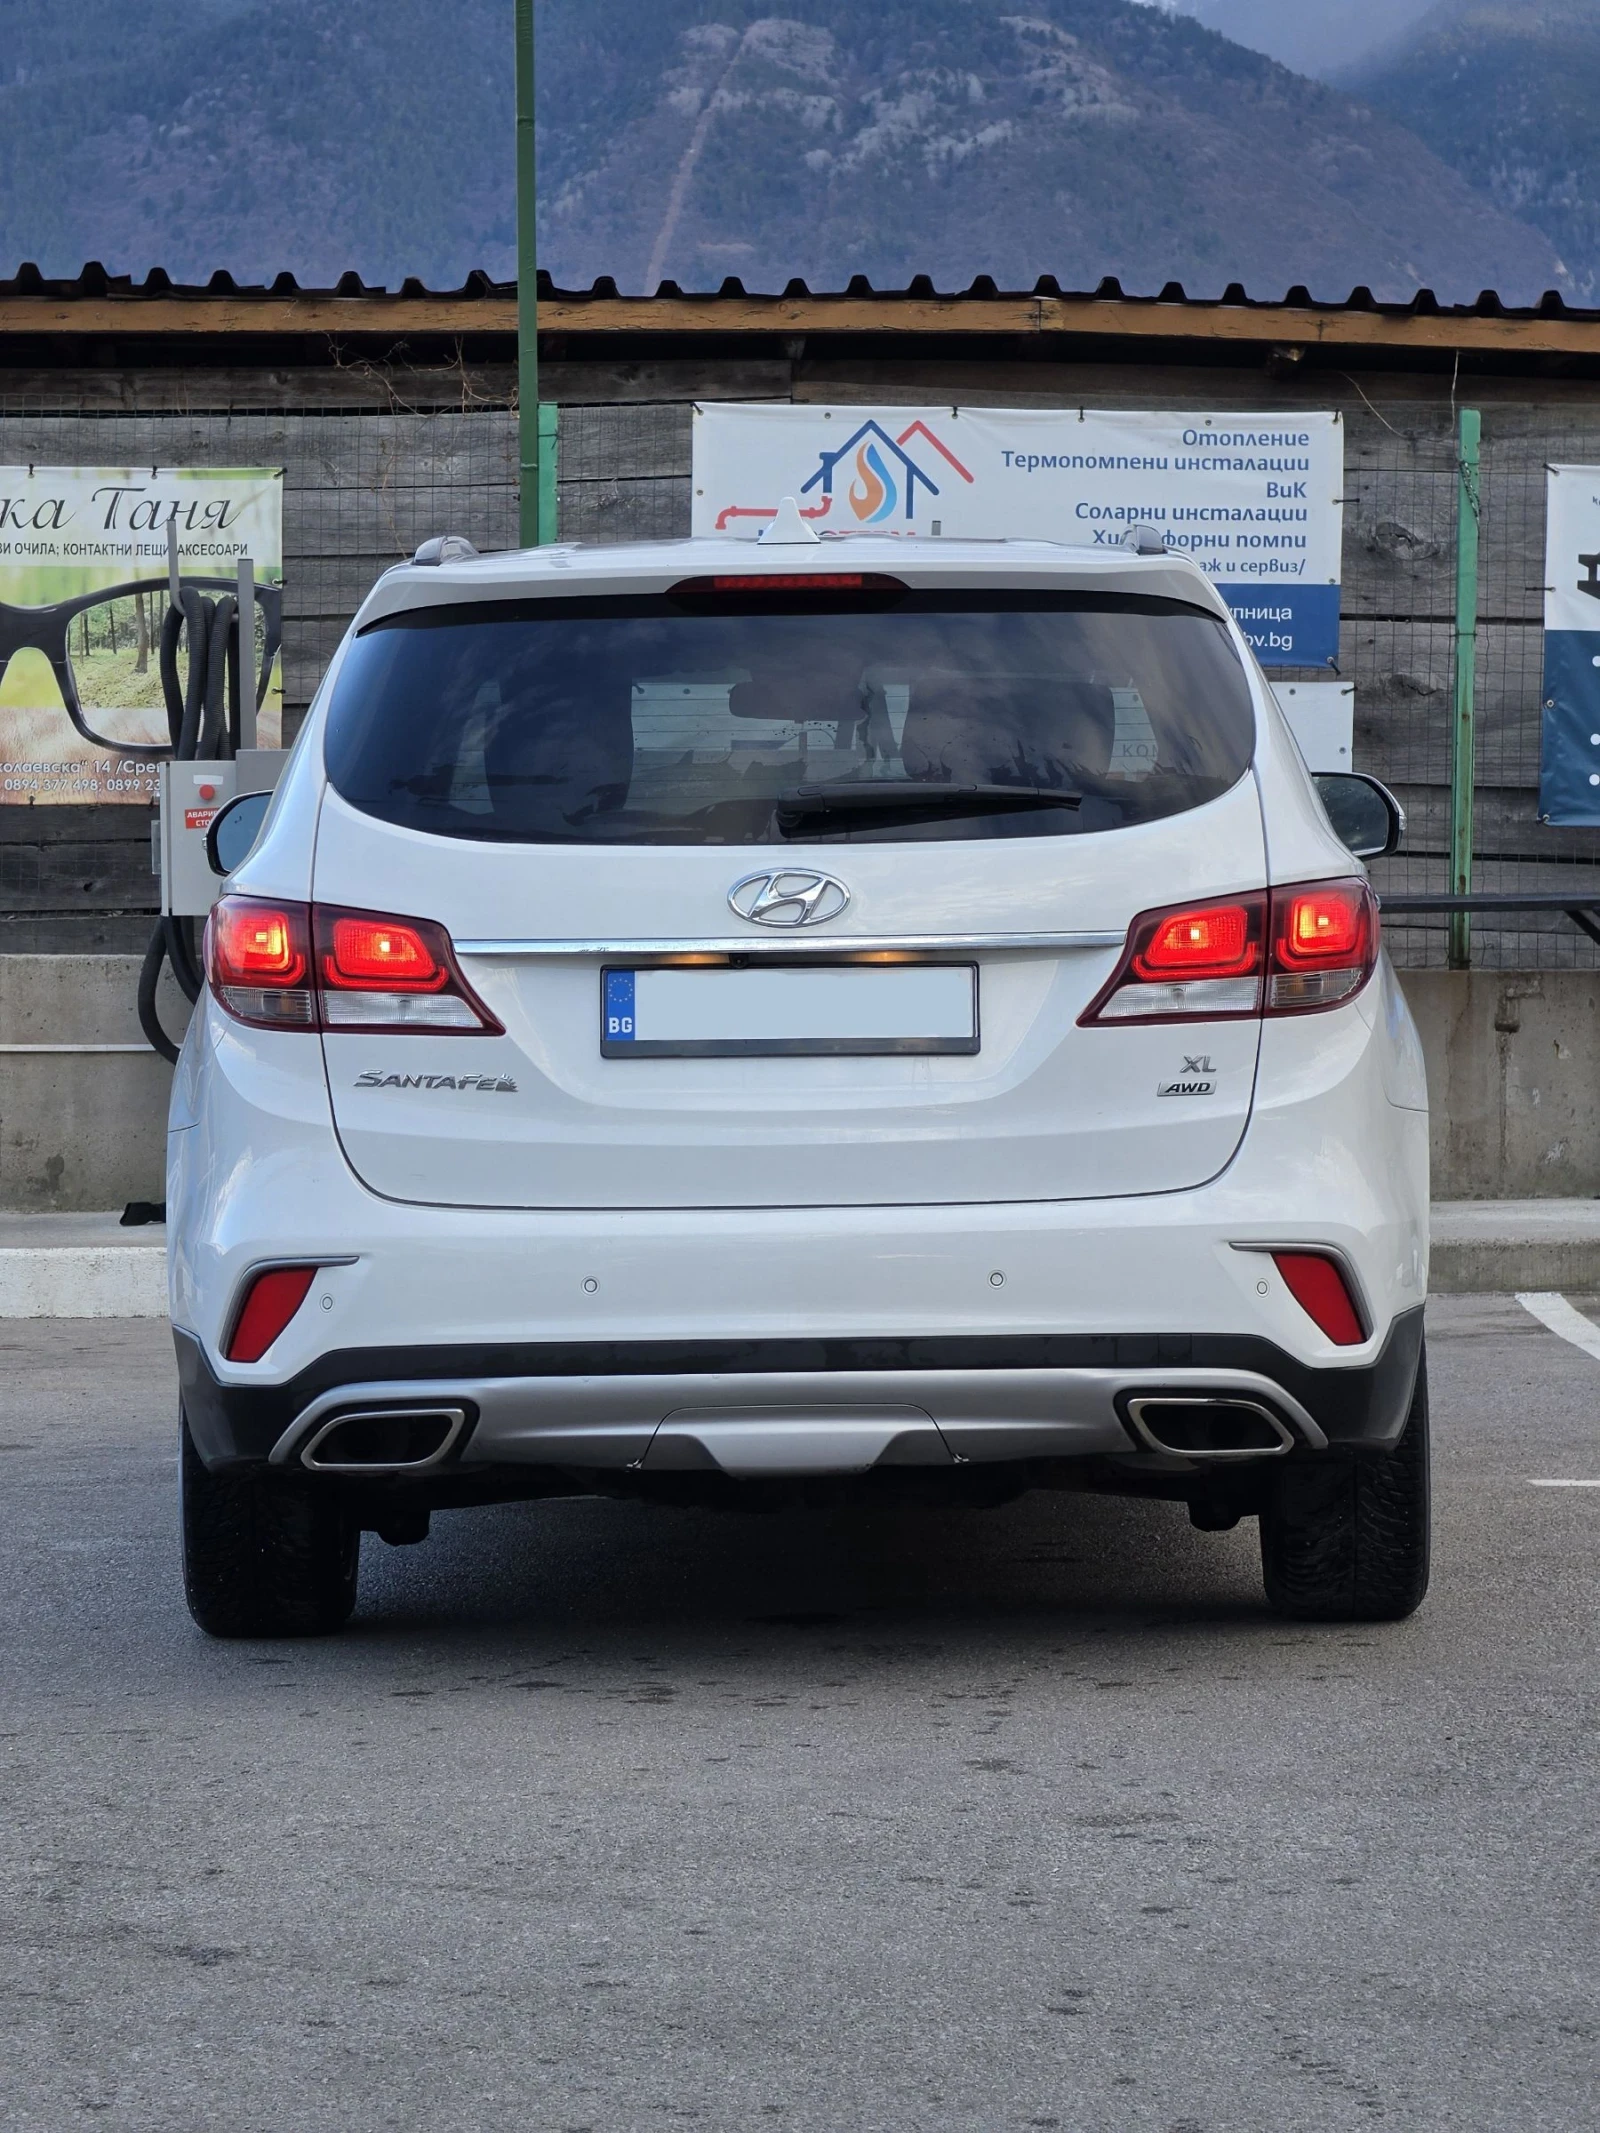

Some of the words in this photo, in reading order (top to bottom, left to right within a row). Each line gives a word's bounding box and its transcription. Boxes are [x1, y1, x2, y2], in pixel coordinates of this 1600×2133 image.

[1182, 429, 1310, 447] Отопление
[1001, 450, 1168, 473] Термопомпени
[1174, 455, 1310, 473] инсталации
[1266, 482, 1307, 499] ВиК
[91, 487, 242, 531] Таня
[1075, 502, 1167, 525] Соларни
[1172, 506, 1308, 524] инсталации
[14, 543, 60, 557] ОЧИЛА;
[63, 543, 132, 556] КОНТАКТНИ
[177, 543, 248, 556] АКСЕСОАРИ
[1236, 534, 1307, 549] помпи
[1226, 562, 1235, 572] и
[93, 760, 111, 773] 14
[4, 779, 38, 791] 0894
[43, 779, 68, 791] 377
[107, 779, 140, 791] 0899
[608, 1017, 633, 1034] BG
[1180, 1055, 1217, 1073] XL
[1164, 1082, 1211, 1094] AWD
